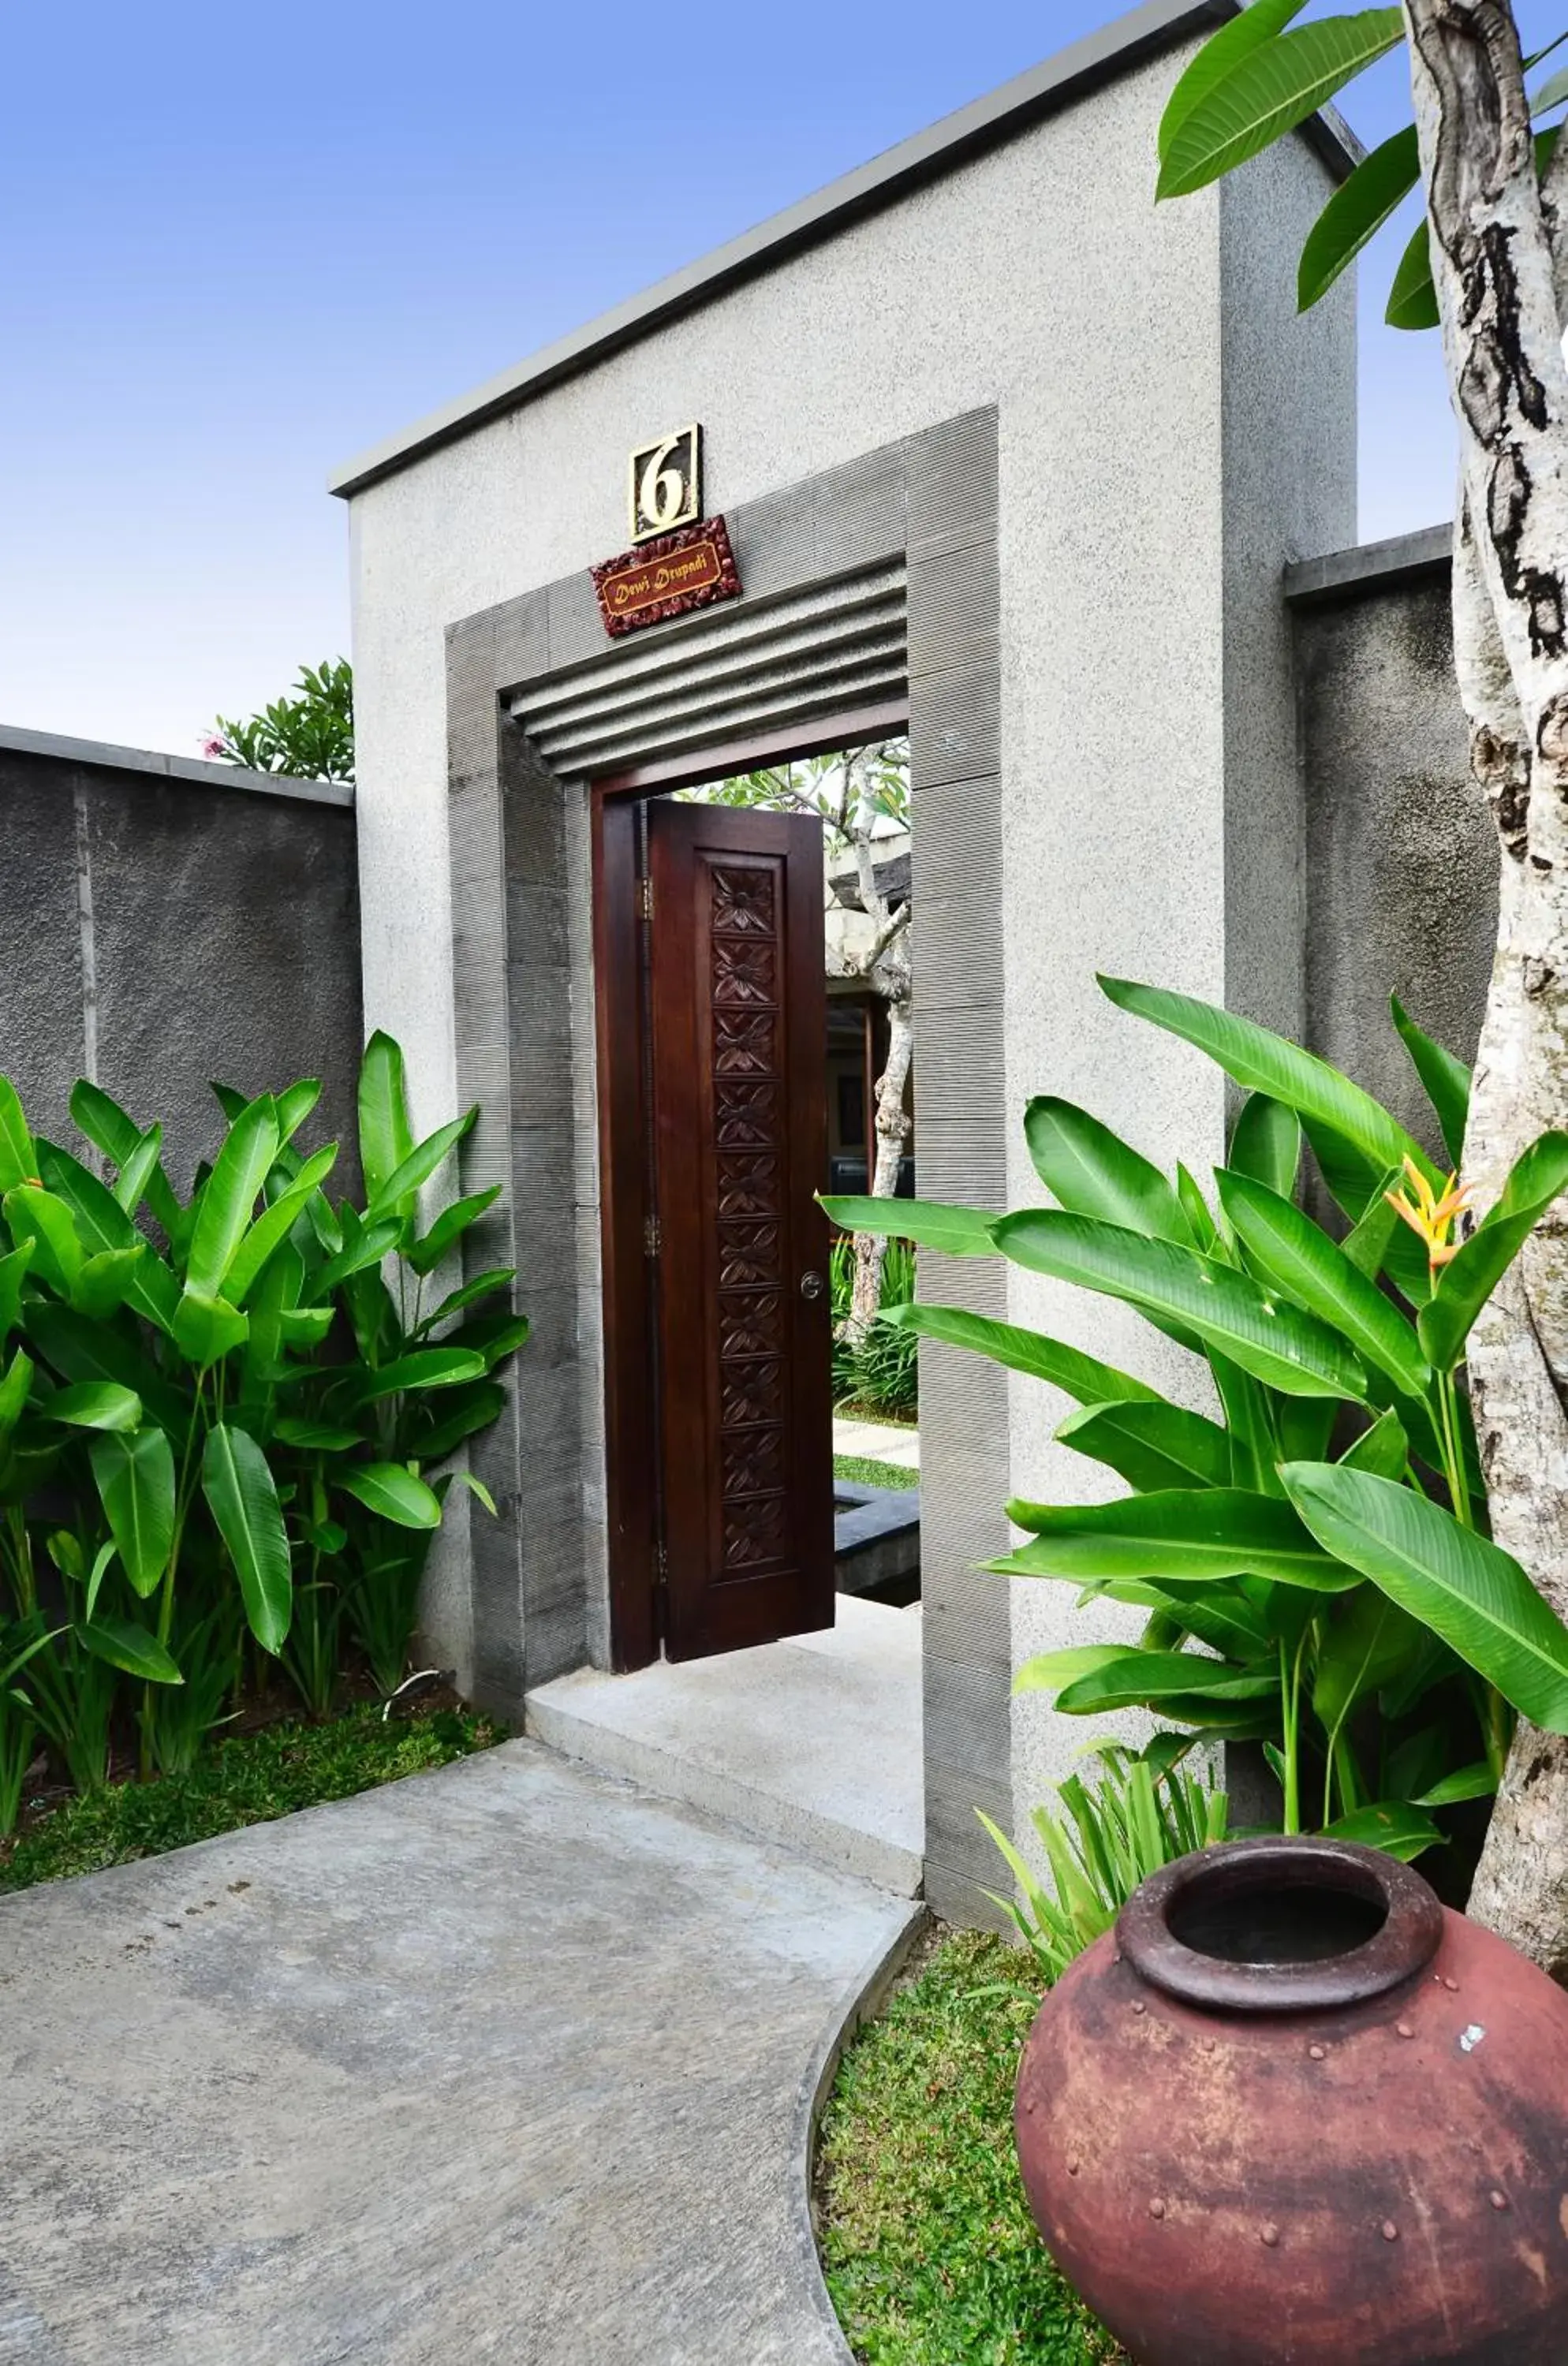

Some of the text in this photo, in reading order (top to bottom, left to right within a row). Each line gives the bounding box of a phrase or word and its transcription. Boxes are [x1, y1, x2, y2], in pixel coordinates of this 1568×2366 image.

[640, 436, 684, 526] 6
[614, 554, 707, 604] Dewi Drupadi
